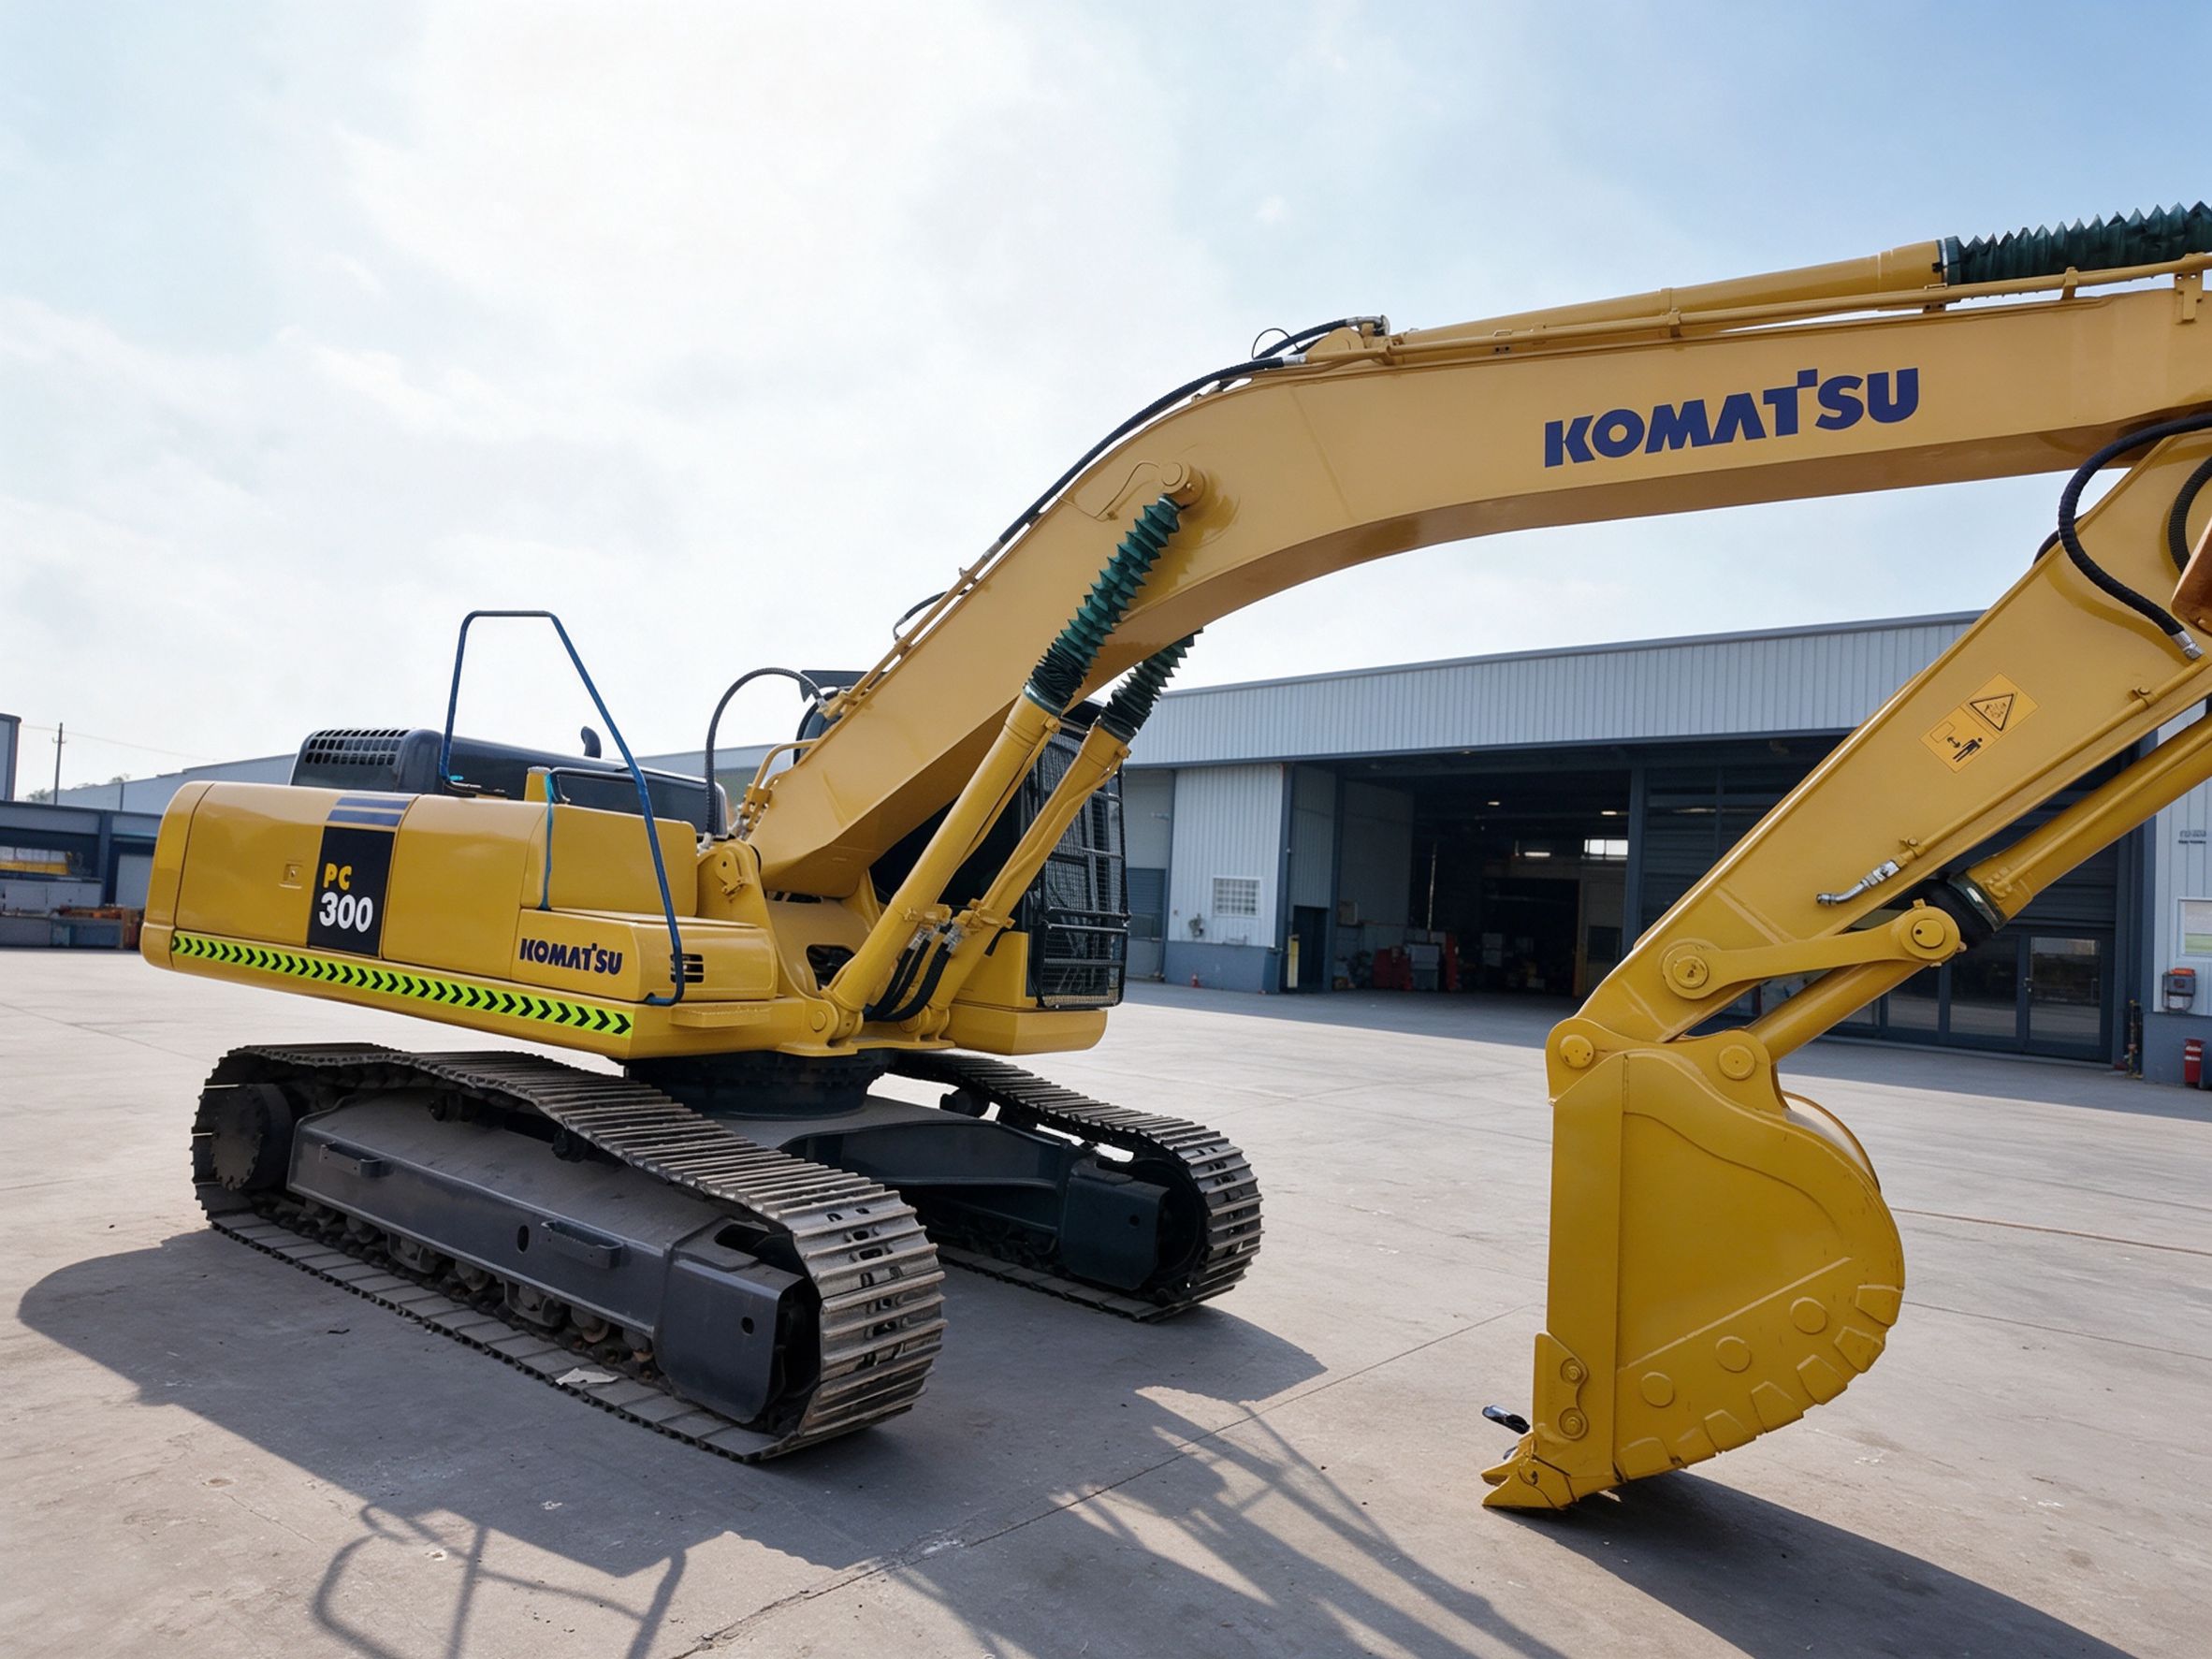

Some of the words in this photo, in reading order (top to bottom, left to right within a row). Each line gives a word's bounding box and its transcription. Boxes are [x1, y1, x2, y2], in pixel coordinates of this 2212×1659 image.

[1545, 368, 1919, 468] KOMATSU
[323, 863, 352, 891] PC
[319, 891, 373, 933] 300
[519, 938, 623, 975] KOMATSU
